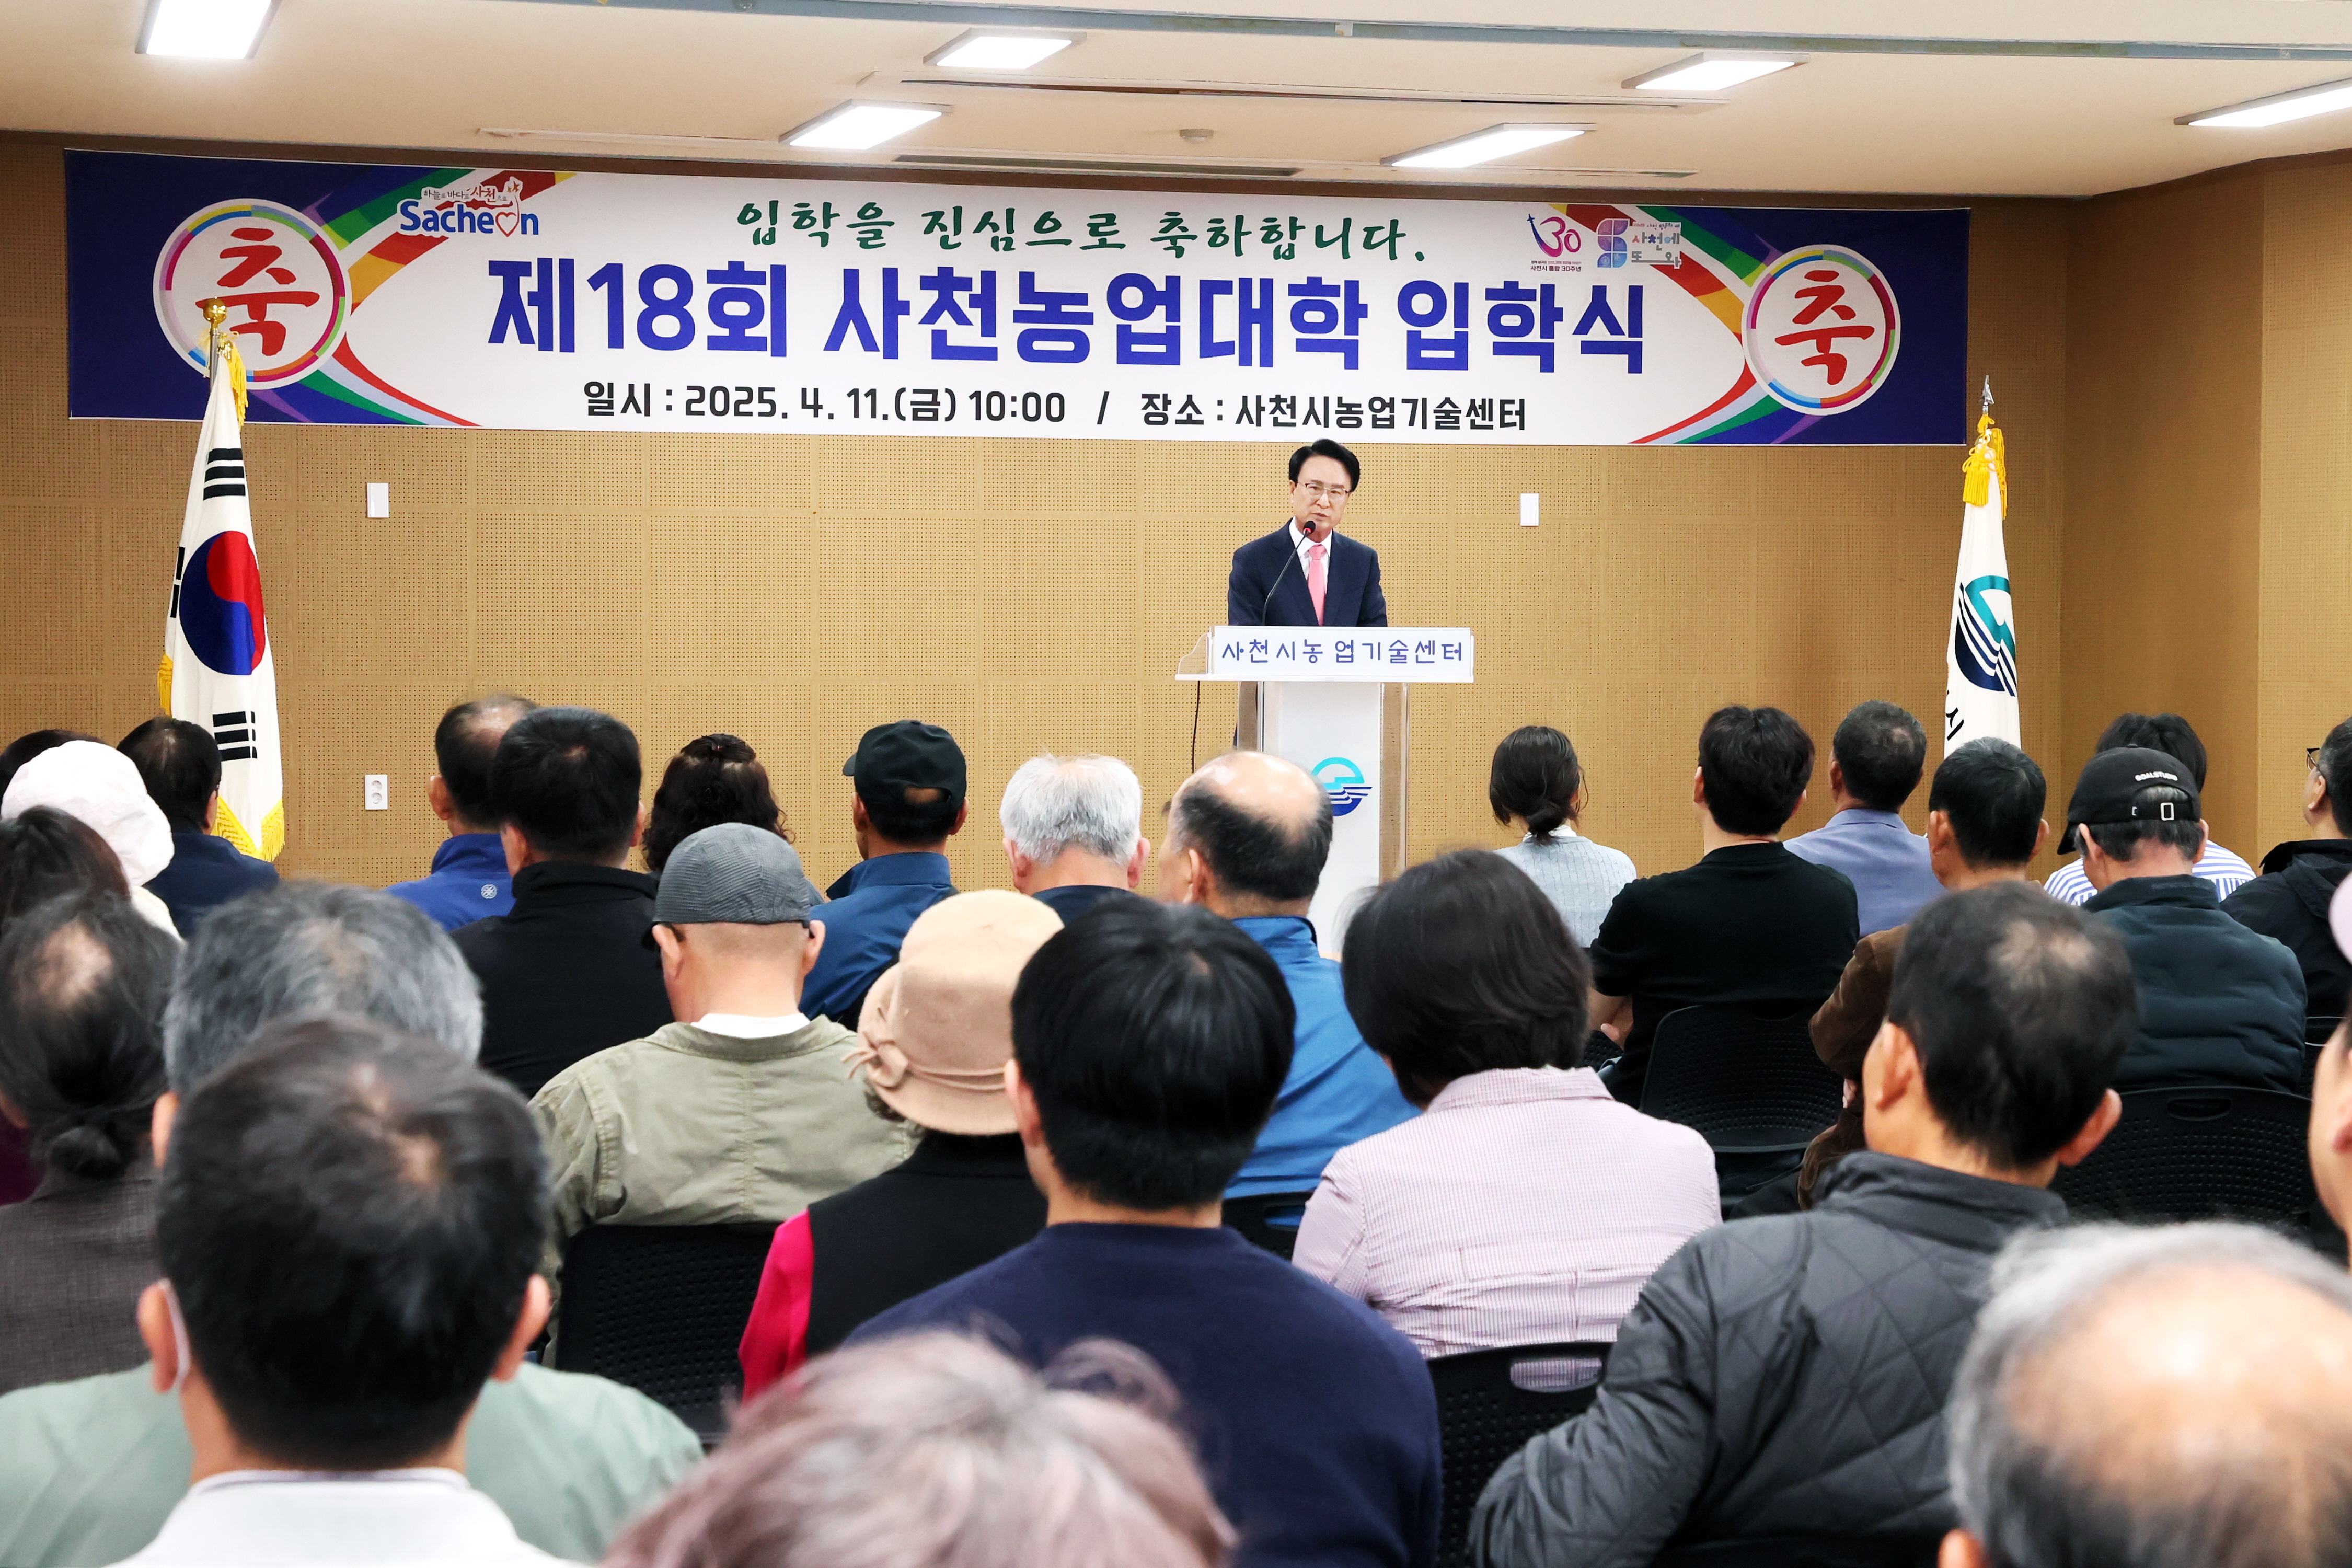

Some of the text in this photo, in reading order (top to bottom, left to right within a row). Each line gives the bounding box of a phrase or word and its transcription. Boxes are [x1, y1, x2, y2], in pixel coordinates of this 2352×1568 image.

[736, 200, 1426, 262] 입학을 진심으로 축하합니다.
[1632, 232, 1680, 251] 사천에
[195, 227, 320, 356] 축
[488, 258, 1643, 374] 제18회 사천농업대학 입학식
[1774, 270, 1875, 385] 축
[583, 381, 651, 417] 일시
[685, 385, 788, 419] 2025.
[968, 390, 1065, 423] 10:00
[1140, 393, 1205, 426] 장소
[1235, 394, 1525, 431] 사천시농업기술센터
